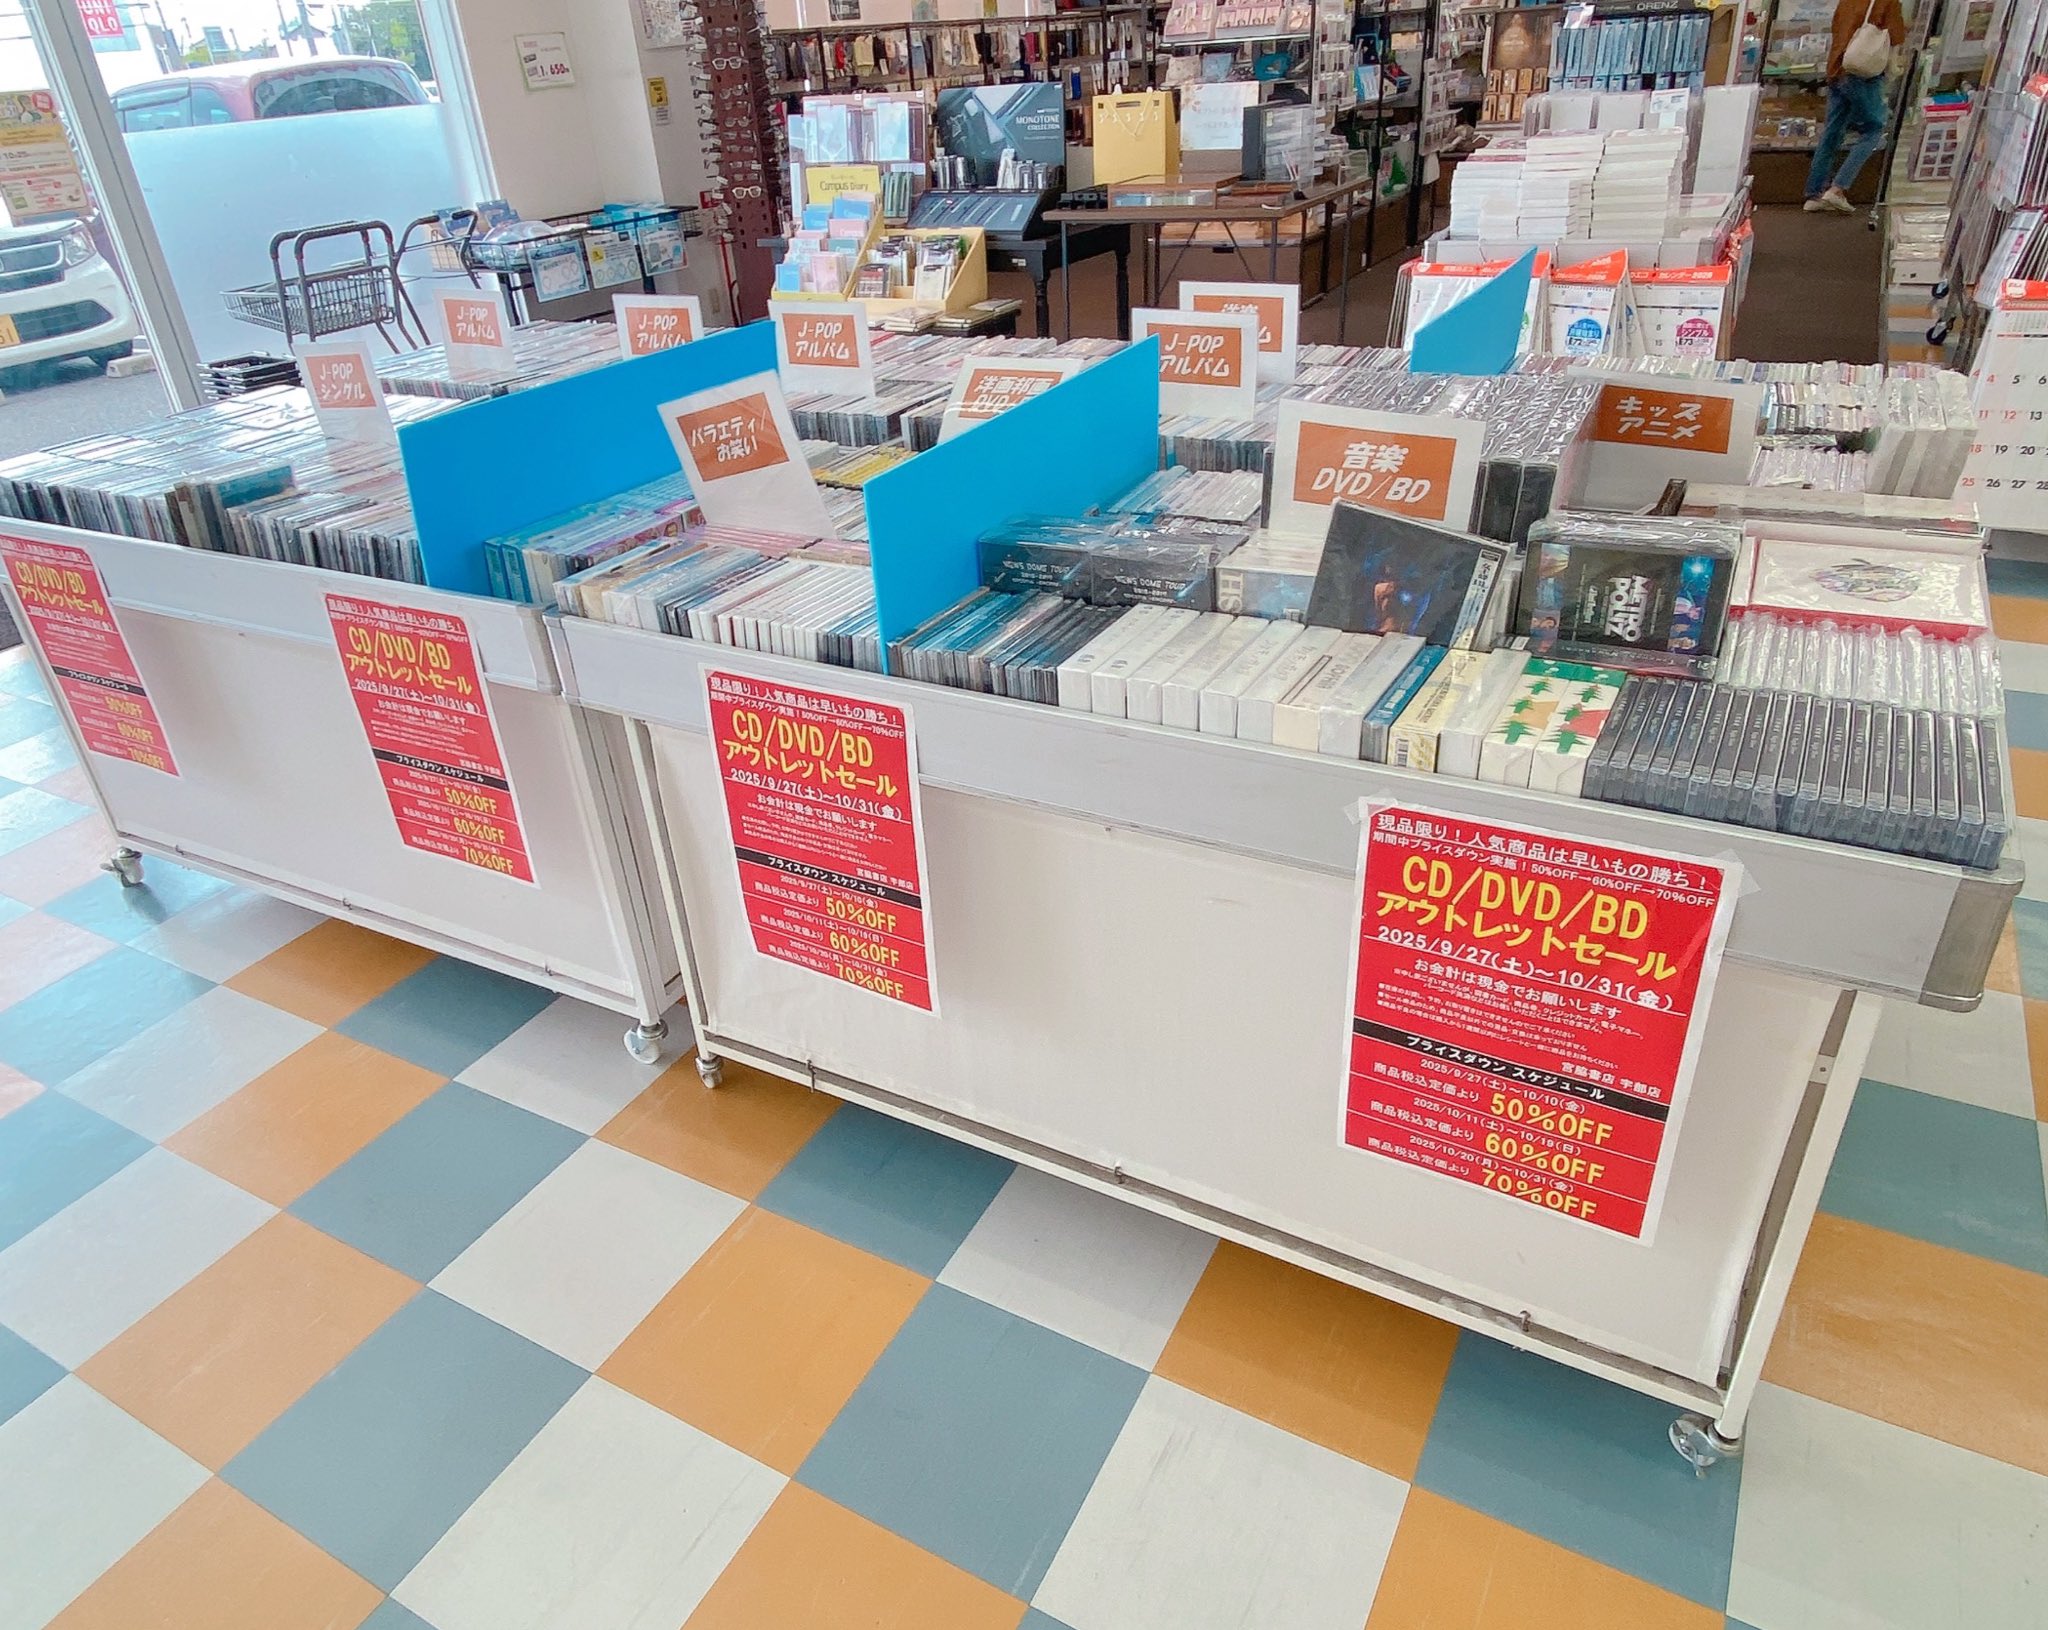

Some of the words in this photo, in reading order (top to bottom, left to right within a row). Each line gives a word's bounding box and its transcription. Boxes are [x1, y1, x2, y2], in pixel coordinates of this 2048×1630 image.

[1637, 0, 1678, 11] ORENZ
[88, 17, 119, 34] QLO
[1016, 114, 1060, 124] MONOTONE
[820, 181, 849, 191] Campus
[456, 306, 489, 321] J-POP
[638, 313, 678, 331] J-POP
[456, 323, 495, 339] アルバム
[797, 321, 842, 339] J-POP
[1165, 333, 1225, 354] J-POP
[795, 341, 850, 360] アルバム
[319, 362, 354, 381] J-POP
[1160, 354, 1230, 377] アルバム
[1987, 375, 1995, 384] 4
[2012, 375, 2020, 384] 5
[2039, 375, 2047, 384] 6
[319, 382, 367, 401] シングル
[1616, 396, 1702, 421] キッズ
[2003, 410, 2016, 420] 12
[2029, 411, 2042, 420] 13
[1618, 416, 1703, 440] アニメ
[717, 435, 757, 462] お笑い
[1342, 441, 1409, 473] 音楽
[1995, 445, 2008, 454] 19
[2020, 446, 2035, 455] 20
[1312, 467, 1432, 504] DVD/BD
[1986, 478, 2000, 488] 26
[2011, 480, 2026, 489] 27
[15, 560, 87, 595] CD/DVD/BD
[1026, 563, 1048, 573] DOME
[1139, 578, 1163, 588] DOME
[1621, 575, 1652, 642] METRO
[348, 627, 451, 670] CD/DVD/BD
[346, 653, 472, 695] アウトレットセール
[732, 709, 874, 768] CD/DVD/BD
[723, 739, 898, 798] アウトレットセール
[444, 786, 497, 815] 50%OFF
[453, 817, 506, 845] 60%OFF
[463, 846, 514, 874] 70%OFF
[768, 857, 828, 880] プライスダウン
[832, 873, 886, 897] スケジュール
[1403, 856, 1649, 940] CD/DVD/BD
[826, 897, 897, 934] 50%OFF
[829, 931, 900, 968] 60%OFF
[1376, 891, 1678, 981] アウトレットセール
[835, 962, 904, 1000] 70%OFF
[1415, 958, 1622, 1019] お会計は現金でお願いします
[1406, 1036, 1506, 1073] プライスダウン
[1512, 1067, 1606, 1100] スケジュール
[1561, 1062, 1616, 1084] 宮脇書店
[1620, 1078, 1662, 1100] 宇部店
[1373, 1061, 1480, 1103] 商品税込定価より
[1490, 1092, 1614, 1146] 50%OFF
[1370, 1100, 1475, 1141] 商品税込定価より
[1485, 1132, 1606, 1184] 60%OFF
[1367, 1137, 1470, 1176] 商品税込定価より
[1481, 1167, 1598, 1219] 70%OFF
